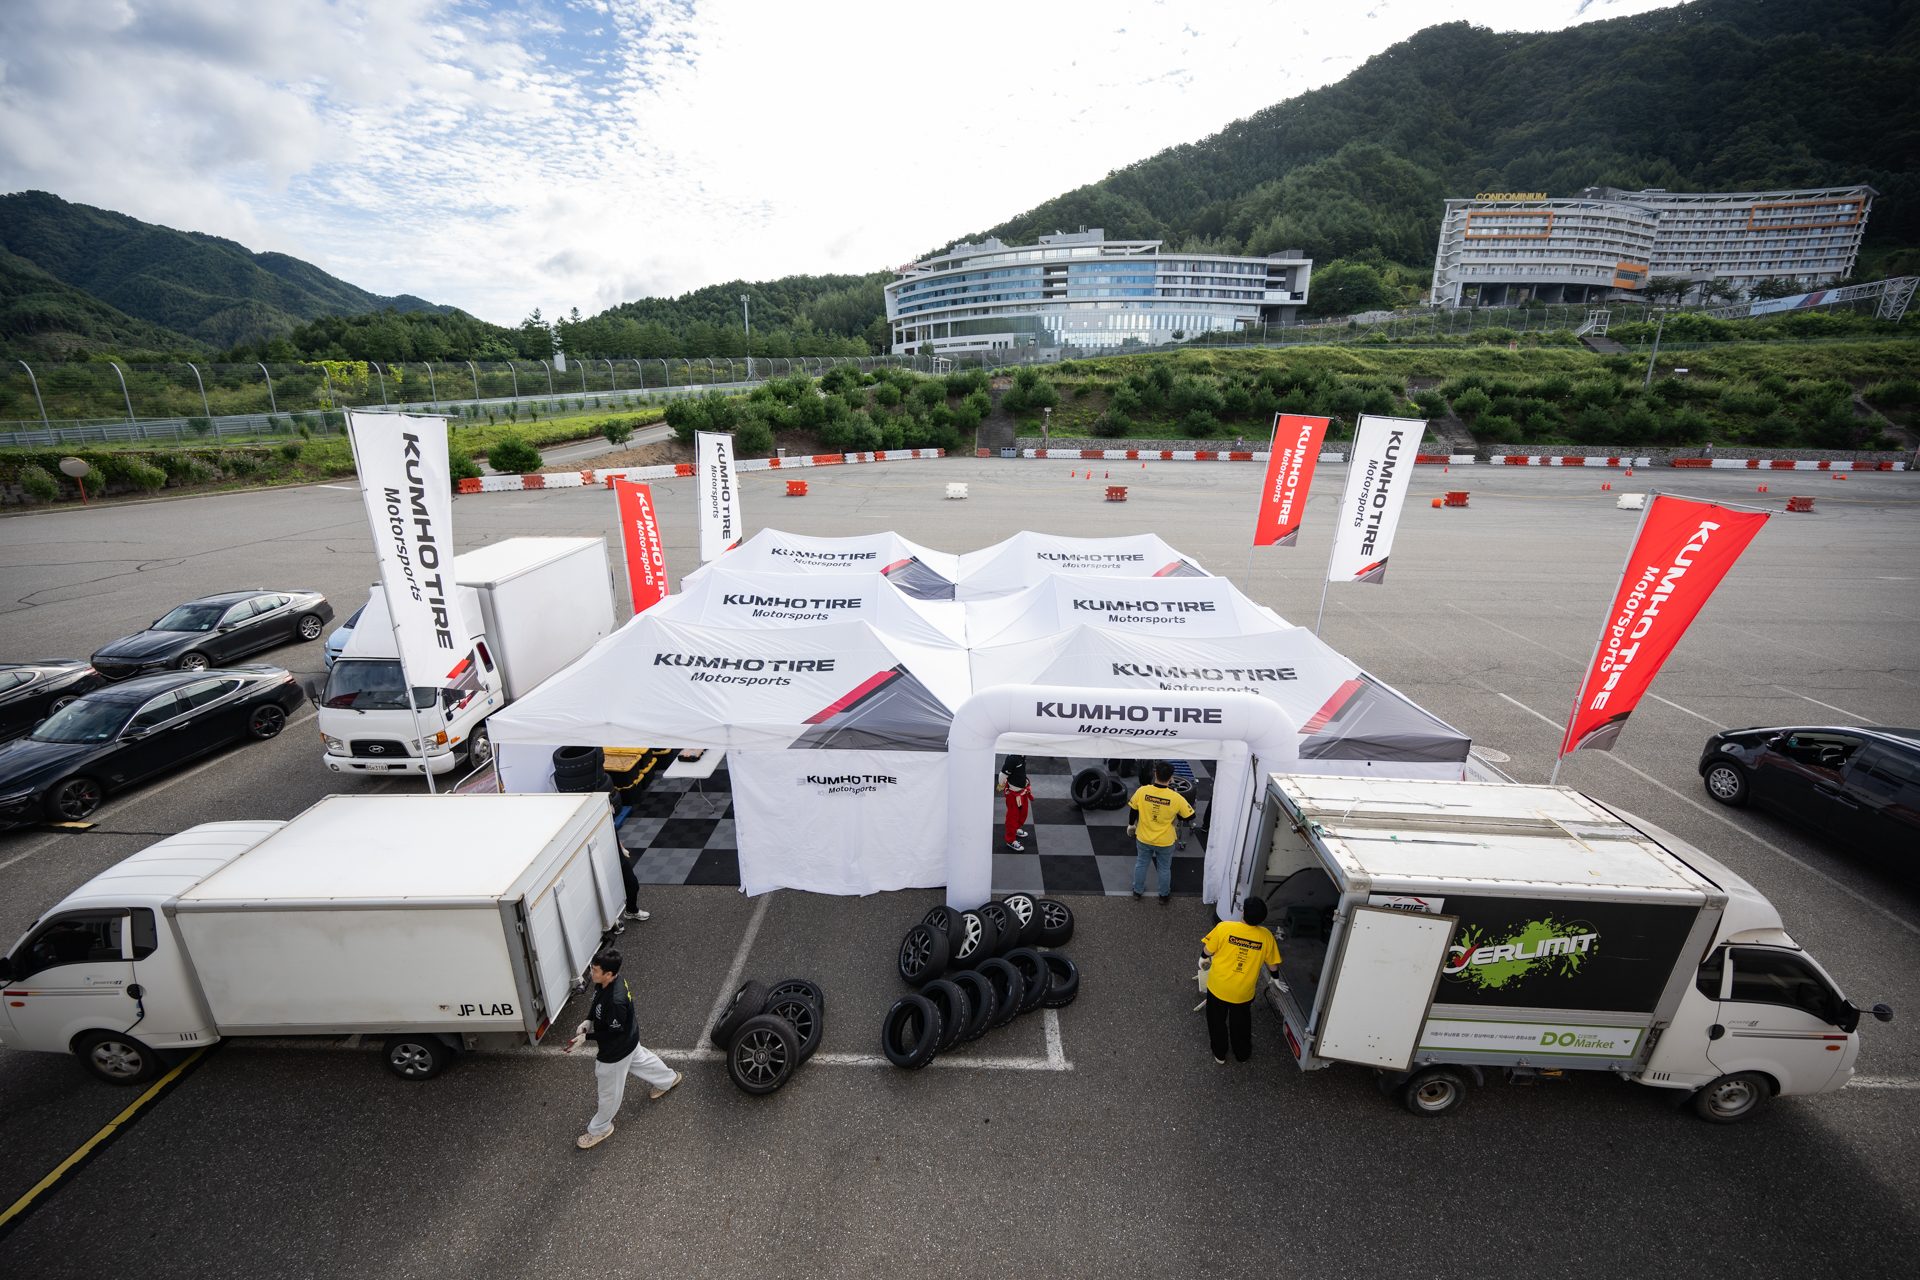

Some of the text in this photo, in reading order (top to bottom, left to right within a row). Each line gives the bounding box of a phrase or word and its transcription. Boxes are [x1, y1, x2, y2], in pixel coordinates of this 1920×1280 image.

[1476, 192, 1547, 201] CONDOMINIUM
[1272, 448, 1292, 503] Motorsports
[1278, 425, 1312, 526] KUMHO TIRE
[710, 465, 719, 519] Motorsports
[716, 442, 731, 540] KUMHO TIRE
[1354, 459, 1379, 528] Motorsports
[1360, 430, 1404, 556] KUMHO TIRE
[384, 487, 422, 602] Motorsports
[402, 432, 454, 650] KUMHO TIRE
[636, 492, 666, 599] KUMHO TIR
[636, 520, 654, 586] Motorsports
[771, 548, 877, 560] KUMHO TIRE
[1037, 552, 1102, 561] KUMHO
[794, 558, 852, 567] Motorsports
[723, 594, 862, 609] KUMHO TIRE
[1073, 599, 1216, 612] KUMHO TIRE
[752, 609, 829, 621] Motorsports
[1108, 614, 1186, 624] Motorsports
[1590, 520, 1720, 710] KUMHO TIRE
[1600, 566, 1660, 672] Motorsports
[653, 653, 836, 672] KUMHO TIRE
[690, 672, 792, 687] Motorsports
[1112, 662, 1298, 682] KUMHO TIRE
[1036, 701, 1222, 724] KUMHO TIRE
[1078, 724, 1179, 737] Motorsports
[806, 775, 898, 785] KUMHO TIRE
[828, 786, 877, 795] Motorsports
[457, 1003, 514, 1017] JP LAB
[1540, 1031, 1576, 1047] DO
[1574, 1039, 1615, 1049] Market
